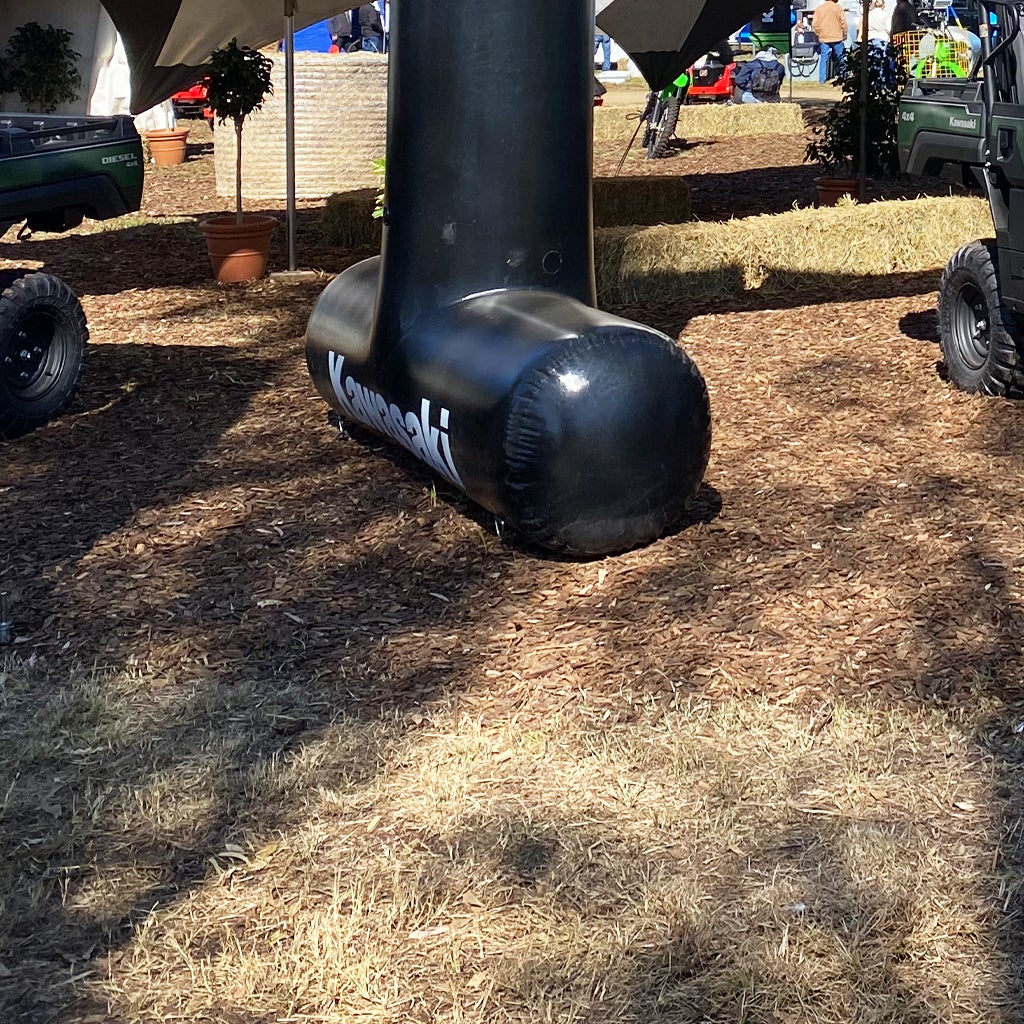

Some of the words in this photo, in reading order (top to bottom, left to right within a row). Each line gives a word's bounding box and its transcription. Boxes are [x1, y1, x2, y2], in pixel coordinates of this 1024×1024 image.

[901, 111, 915, 122] 4x4
[949, 116, 977, 129] Kawasaki
[101, 153, 138, 165] DIESEL
[328, 350, 466, 490] Kawasaki
